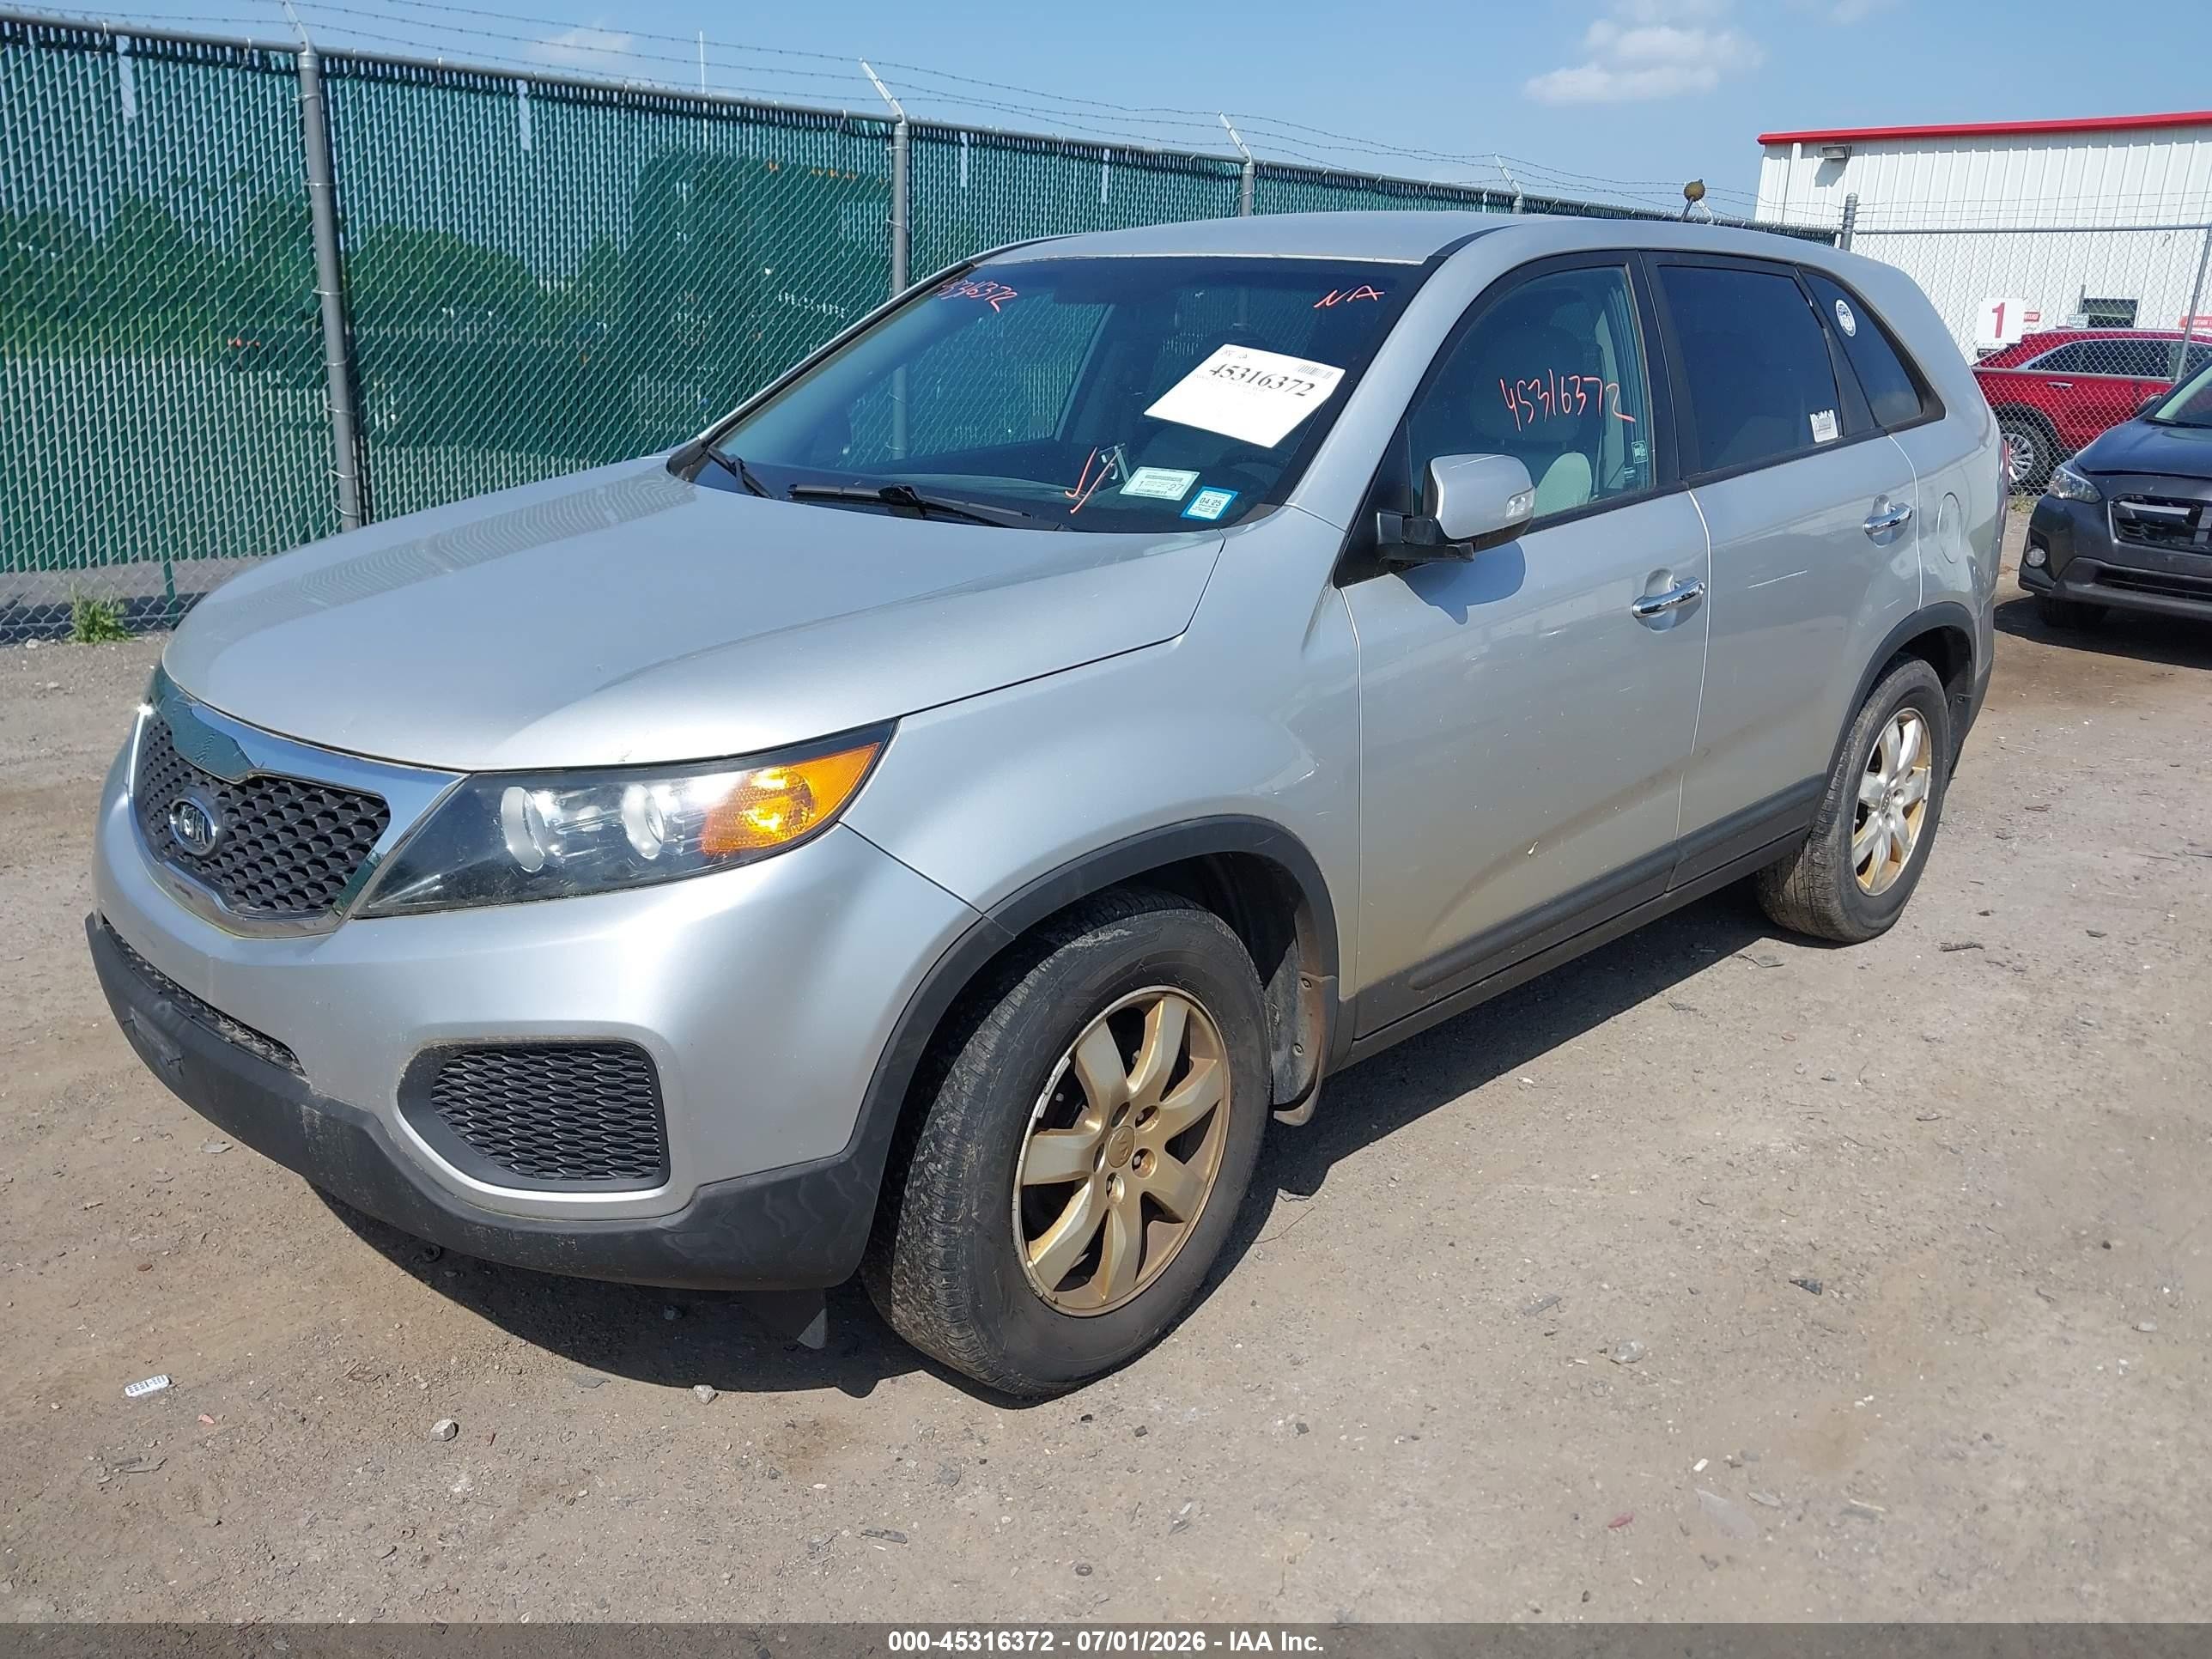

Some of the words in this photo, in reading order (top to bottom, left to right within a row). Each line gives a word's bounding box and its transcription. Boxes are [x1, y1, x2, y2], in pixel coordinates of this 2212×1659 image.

[1991, 301, 2006, 338] 1
[1209, 363, 1316, 397] 45316372
[1500, 368, 1636, 431] 45316372
[1168, 483, 1184, 492] 27
